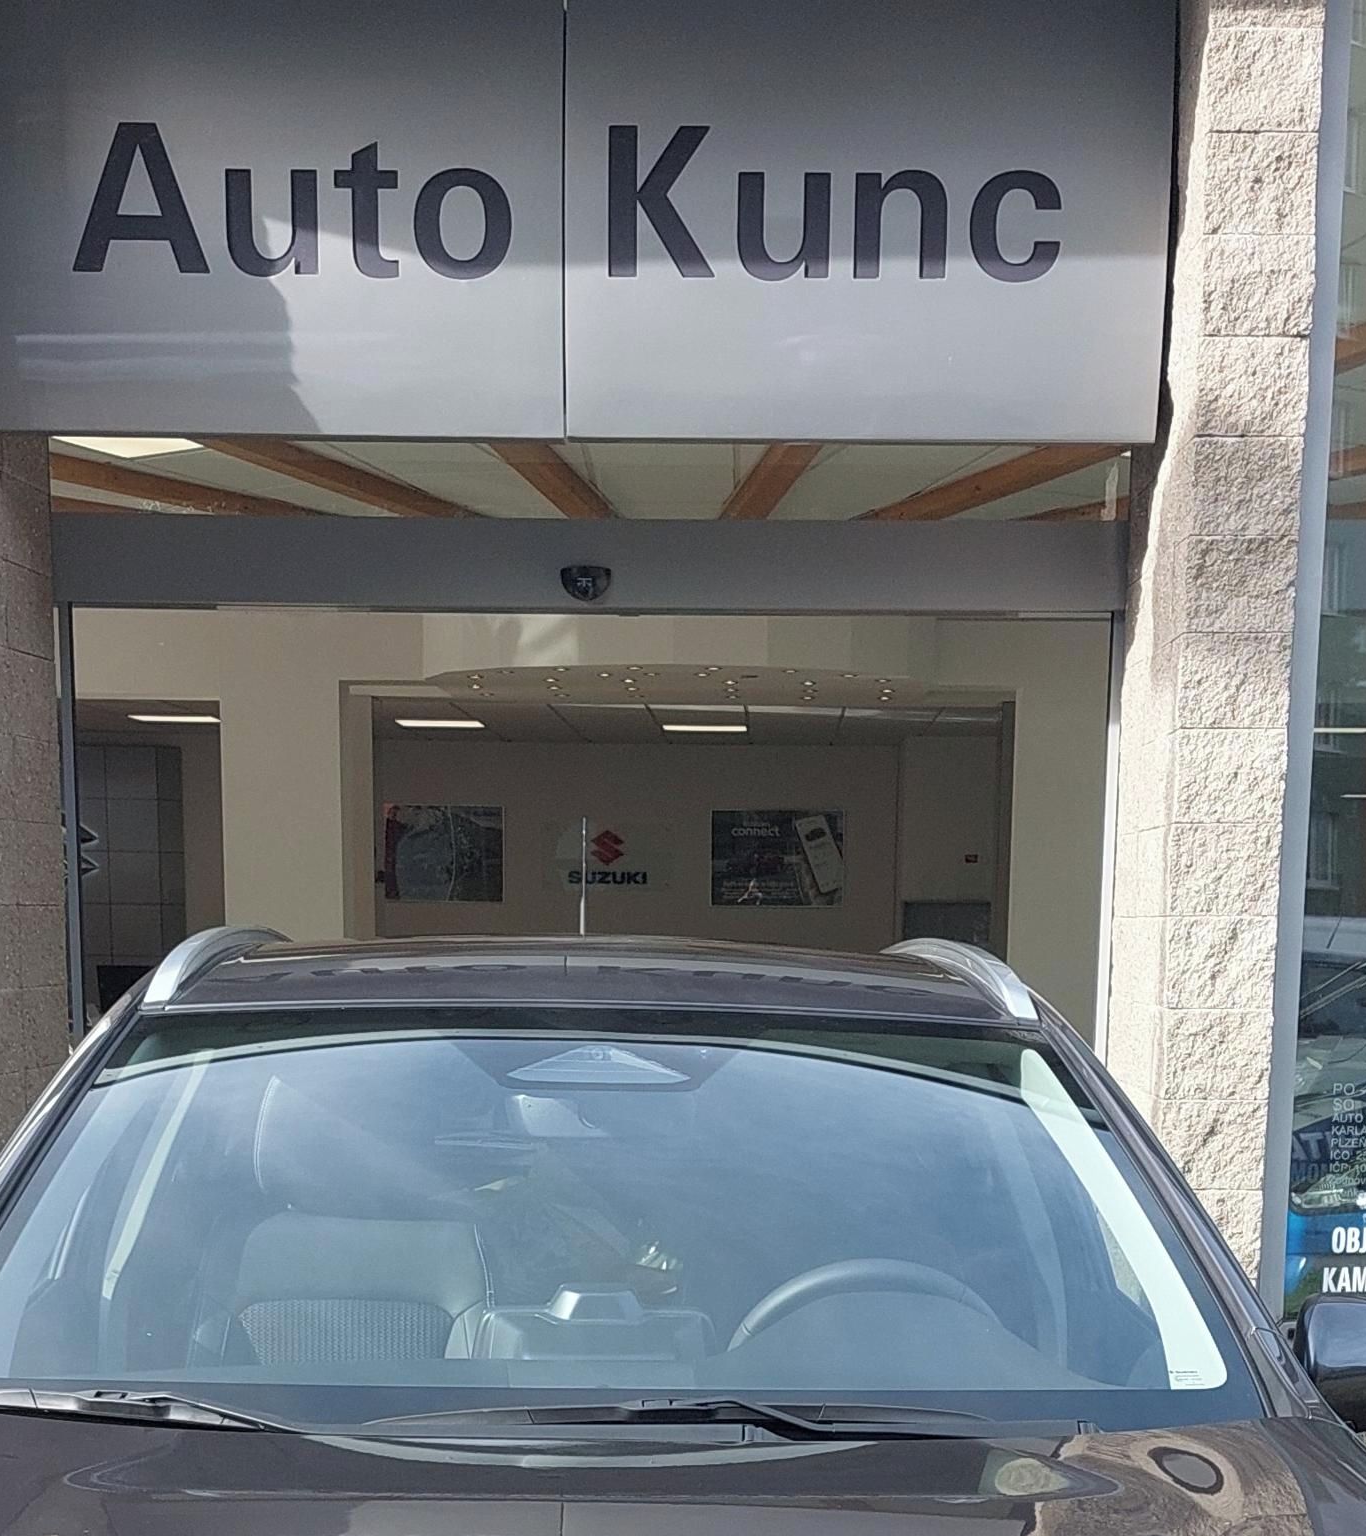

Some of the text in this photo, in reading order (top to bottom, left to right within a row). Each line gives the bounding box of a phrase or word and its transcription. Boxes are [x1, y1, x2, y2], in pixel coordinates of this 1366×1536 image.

[71, 121, 1063, 284] Auto Kunc
[567, 870, 648, 885] SUZUKI
[1332, 1082, 1356, 1096] PO
[1332, 1097, 1355, 1112] SO
[1331, 1113, 1364, 1123] AUTO
[1330, 1135, 1366, 1148] PLZEŇ
